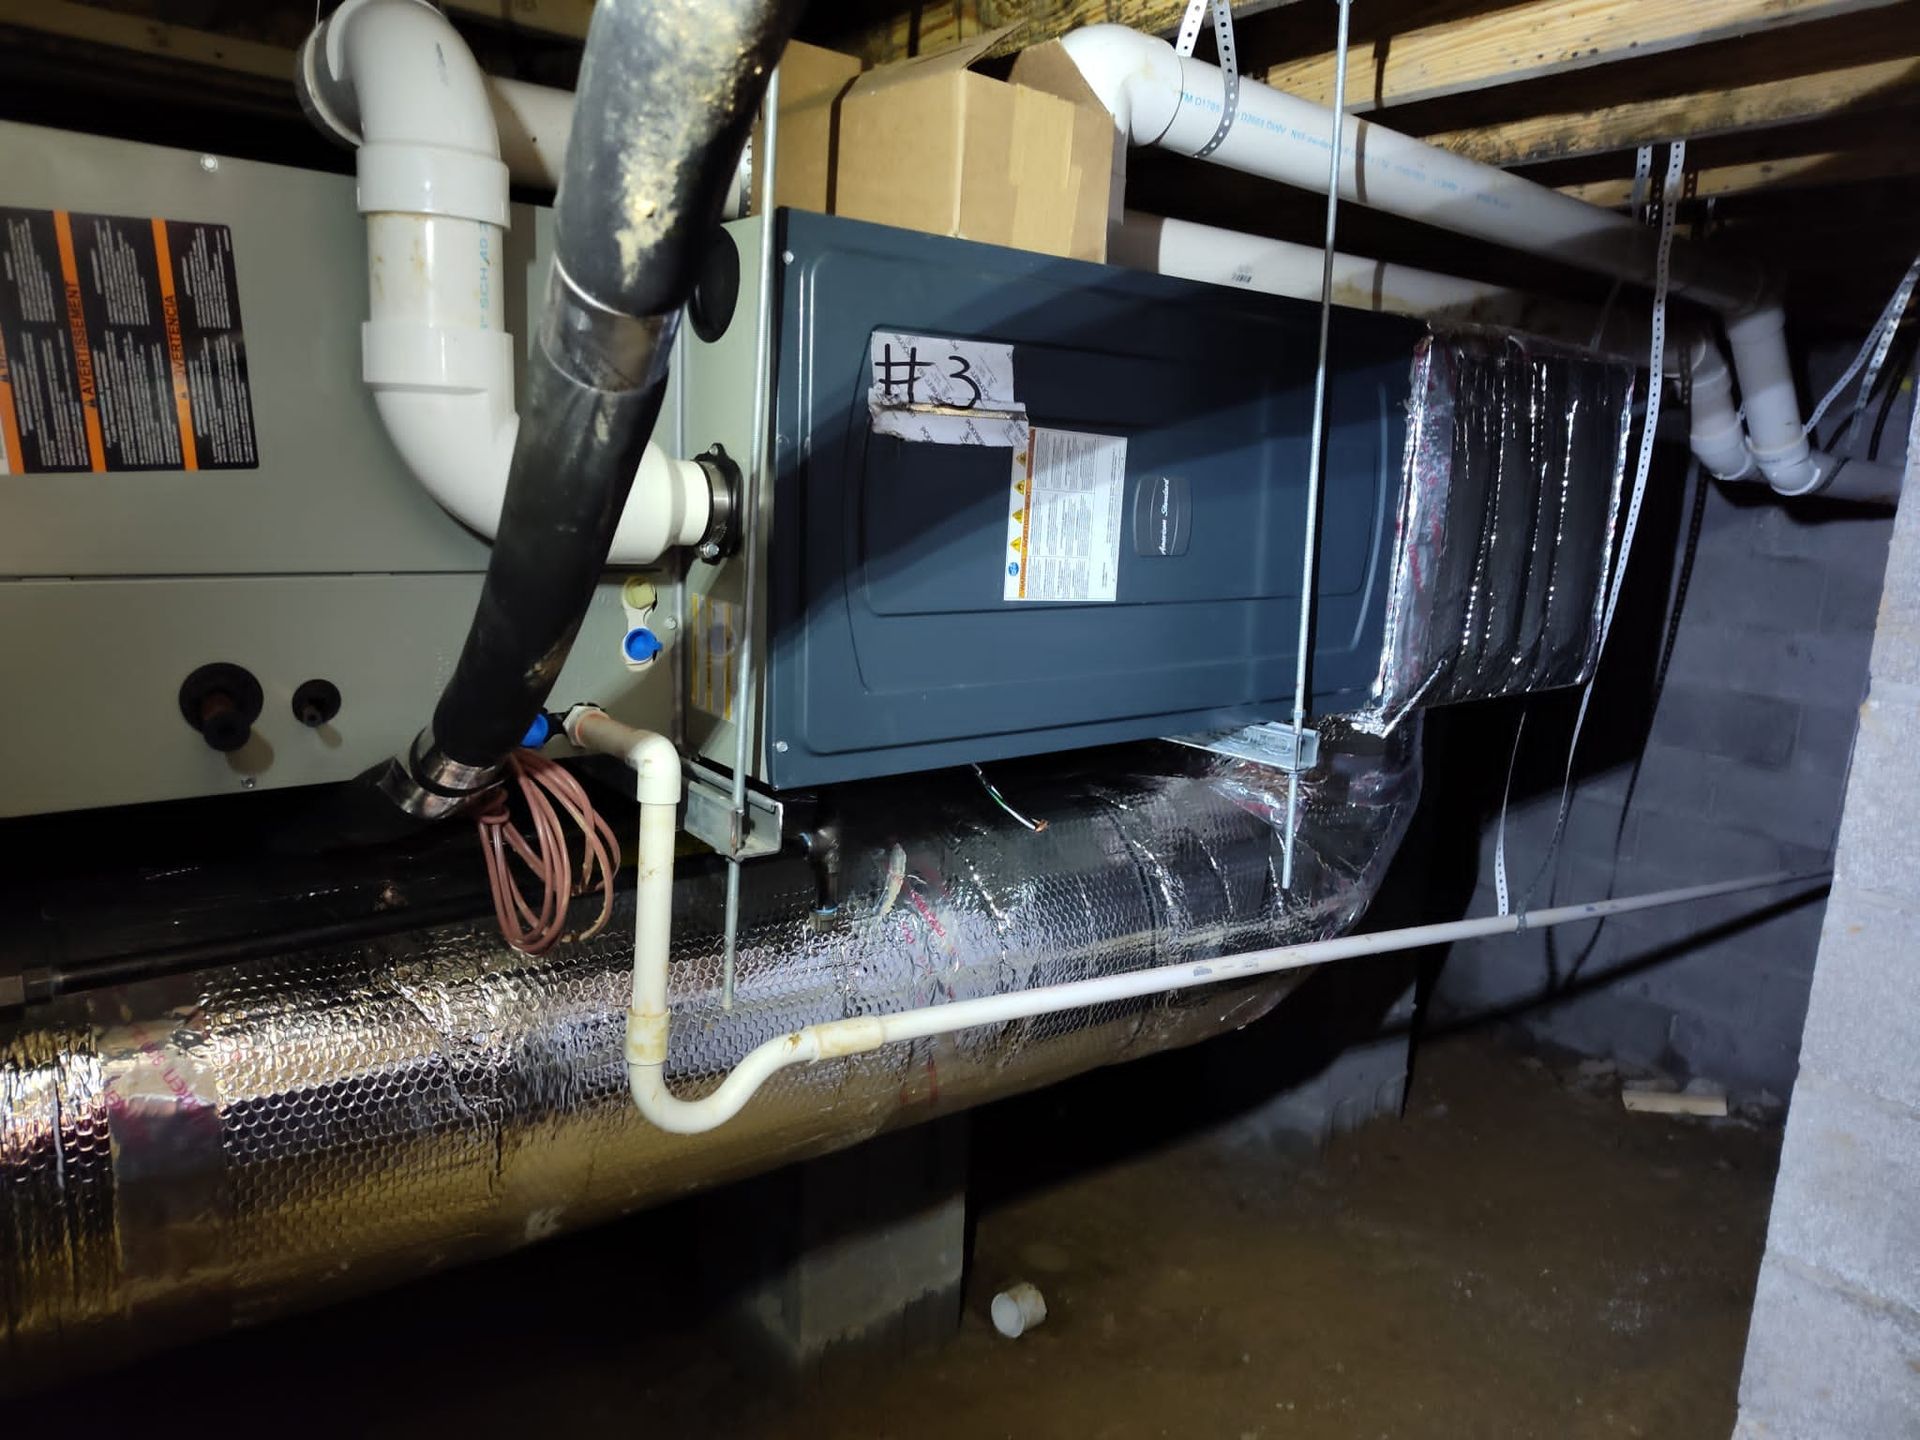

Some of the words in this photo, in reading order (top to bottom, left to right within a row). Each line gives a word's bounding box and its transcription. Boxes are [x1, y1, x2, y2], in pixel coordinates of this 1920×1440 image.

[65, 282, 95, 396] AVERTISSEMENT
[875, 343, 982, 409] #3
[1160, 477, 1170, 517] Standard
[1158, 519, 1167, 555] American
